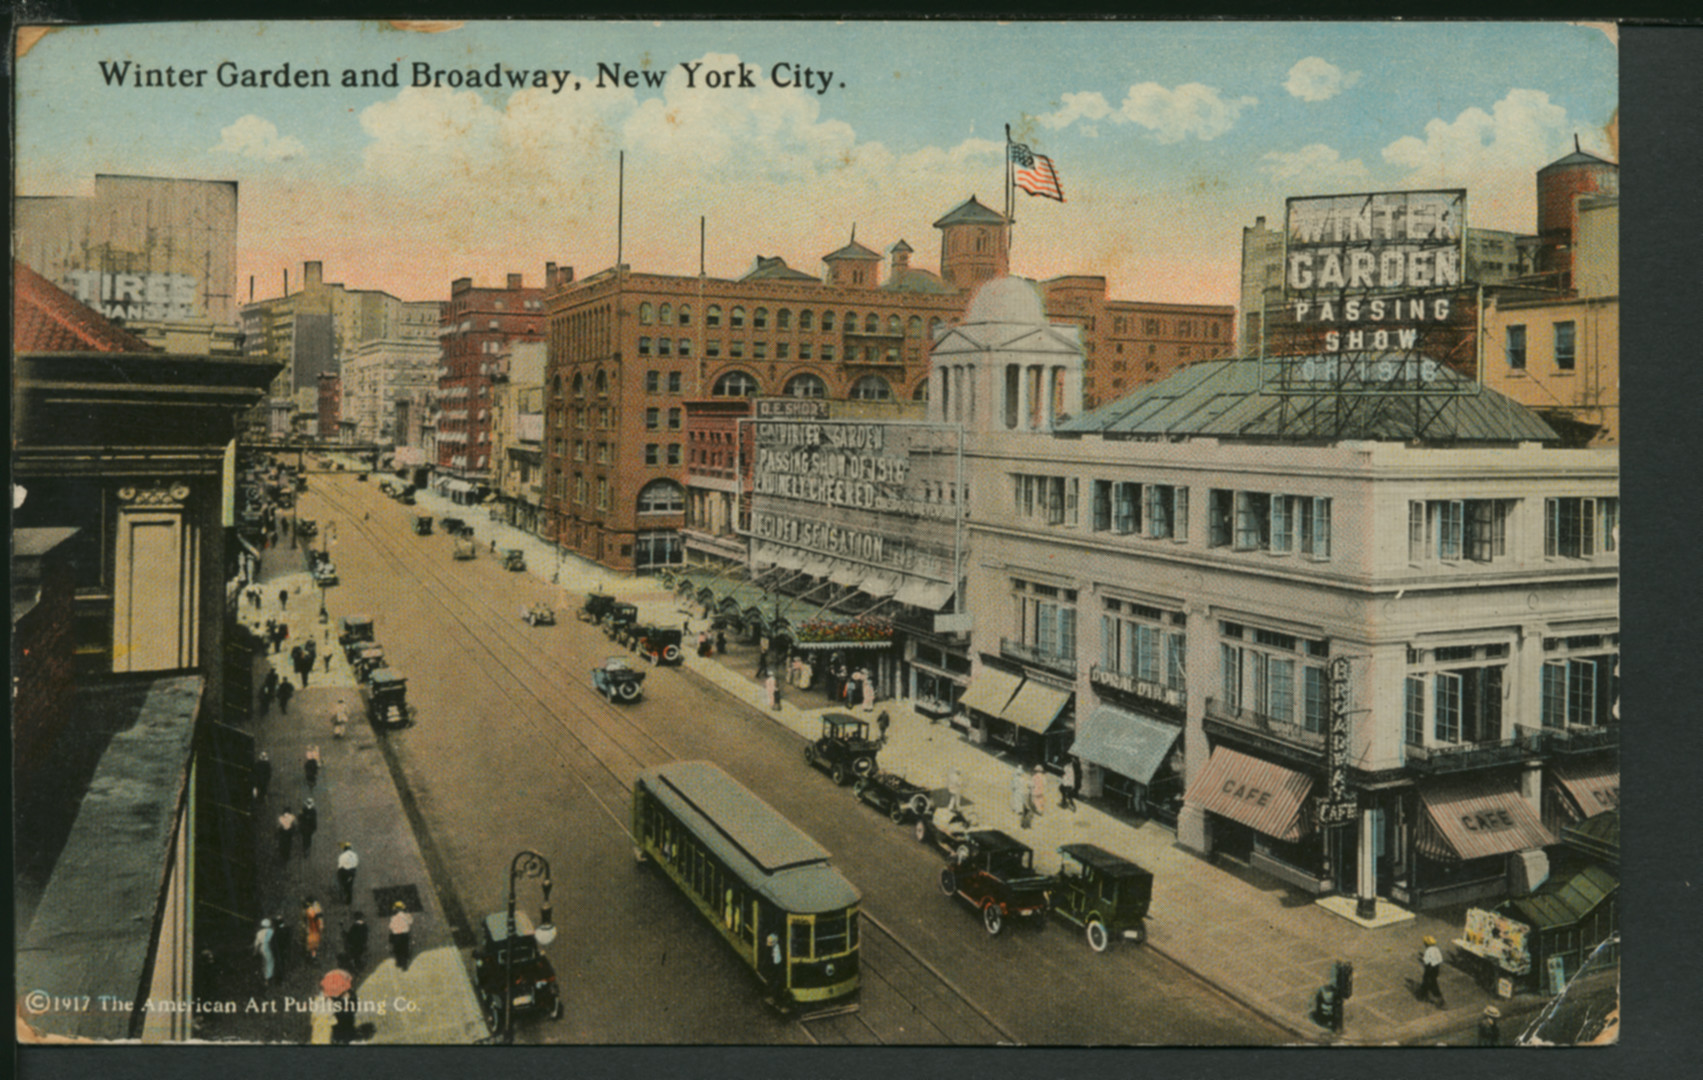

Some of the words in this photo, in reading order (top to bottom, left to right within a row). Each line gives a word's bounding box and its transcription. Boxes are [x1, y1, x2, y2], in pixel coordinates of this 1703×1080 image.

[1293, 203, 1455, 242] WINTER
[1289, 247, 1460, 290] GARDEN
[1296, 299, 1451, 322] PASSING
[1325, 329, 1417, 352] SHOW
[760, 449, 809, 474] PASSING
[811, 451, 846, 479] SHOW
[1222, 779, 1272, 807] CAFE
[1319, 802, 1358, 823] CAFE
[1461, 810, 1514, 832] CAFE
